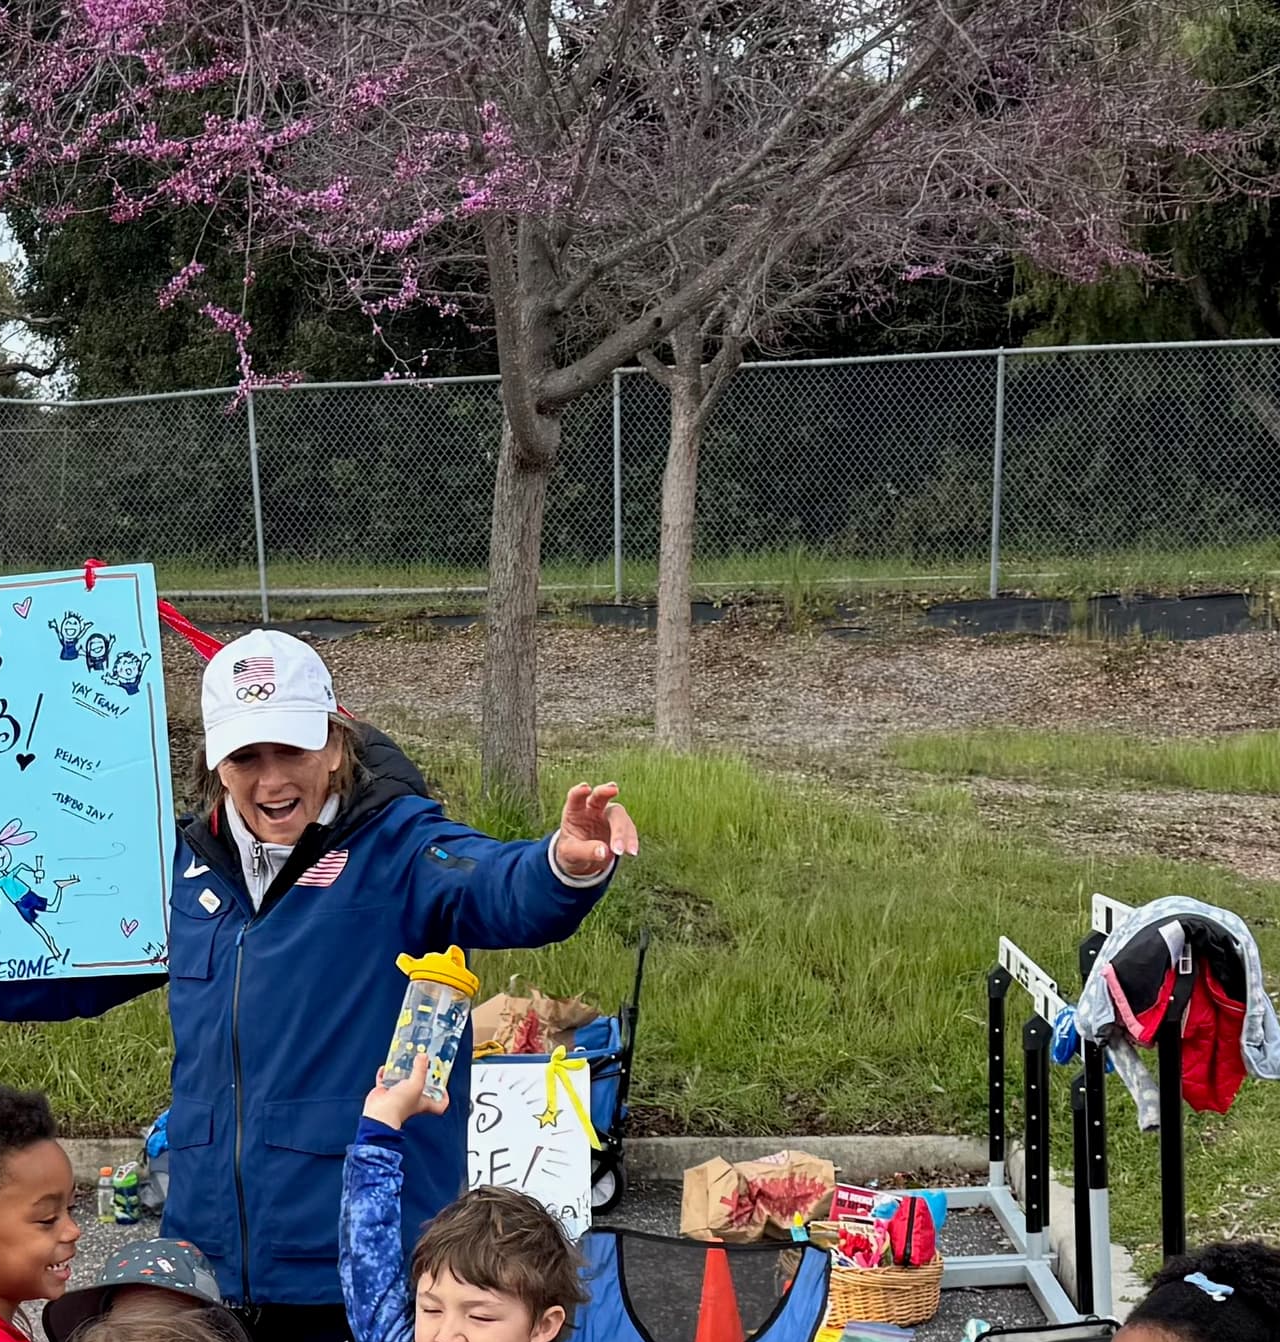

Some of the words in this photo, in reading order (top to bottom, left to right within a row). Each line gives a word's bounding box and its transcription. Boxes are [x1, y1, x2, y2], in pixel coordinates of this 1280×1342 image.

[72, 681, 93, 698] YAY
[93, 692, 130, 719] TEAM!
[54, 747, 101, 773] RELAYS!
[468, 1092, 503, 1134] S
